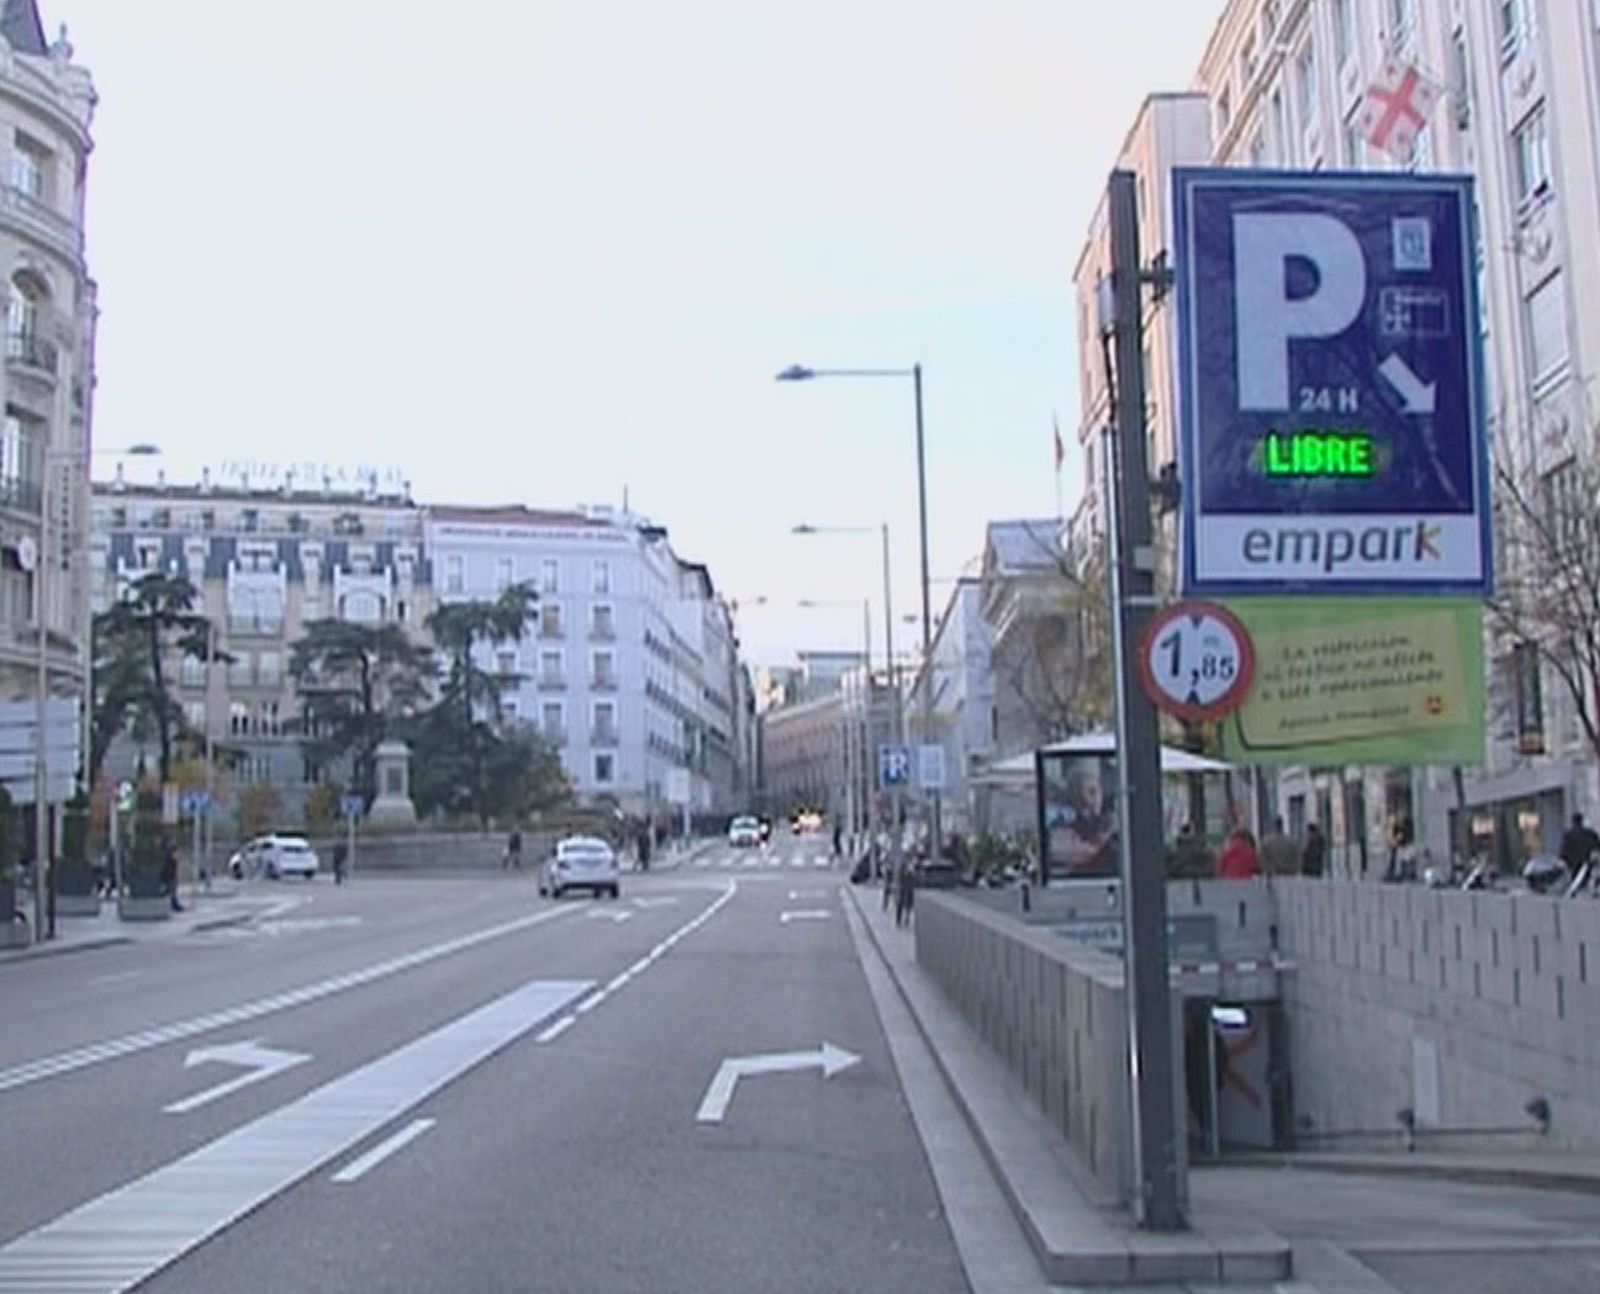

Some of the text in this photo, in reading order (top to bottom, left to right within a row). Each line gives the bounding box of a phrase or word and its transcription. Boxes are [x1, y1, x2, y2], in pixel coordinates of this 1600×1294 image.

[1232, 213, 1367, 411] P
[1300, 387, 1359, 412] 24 H
[1268, 433, 1371, 474] LIBRE
[1243, 519, 1442, 574] empark
